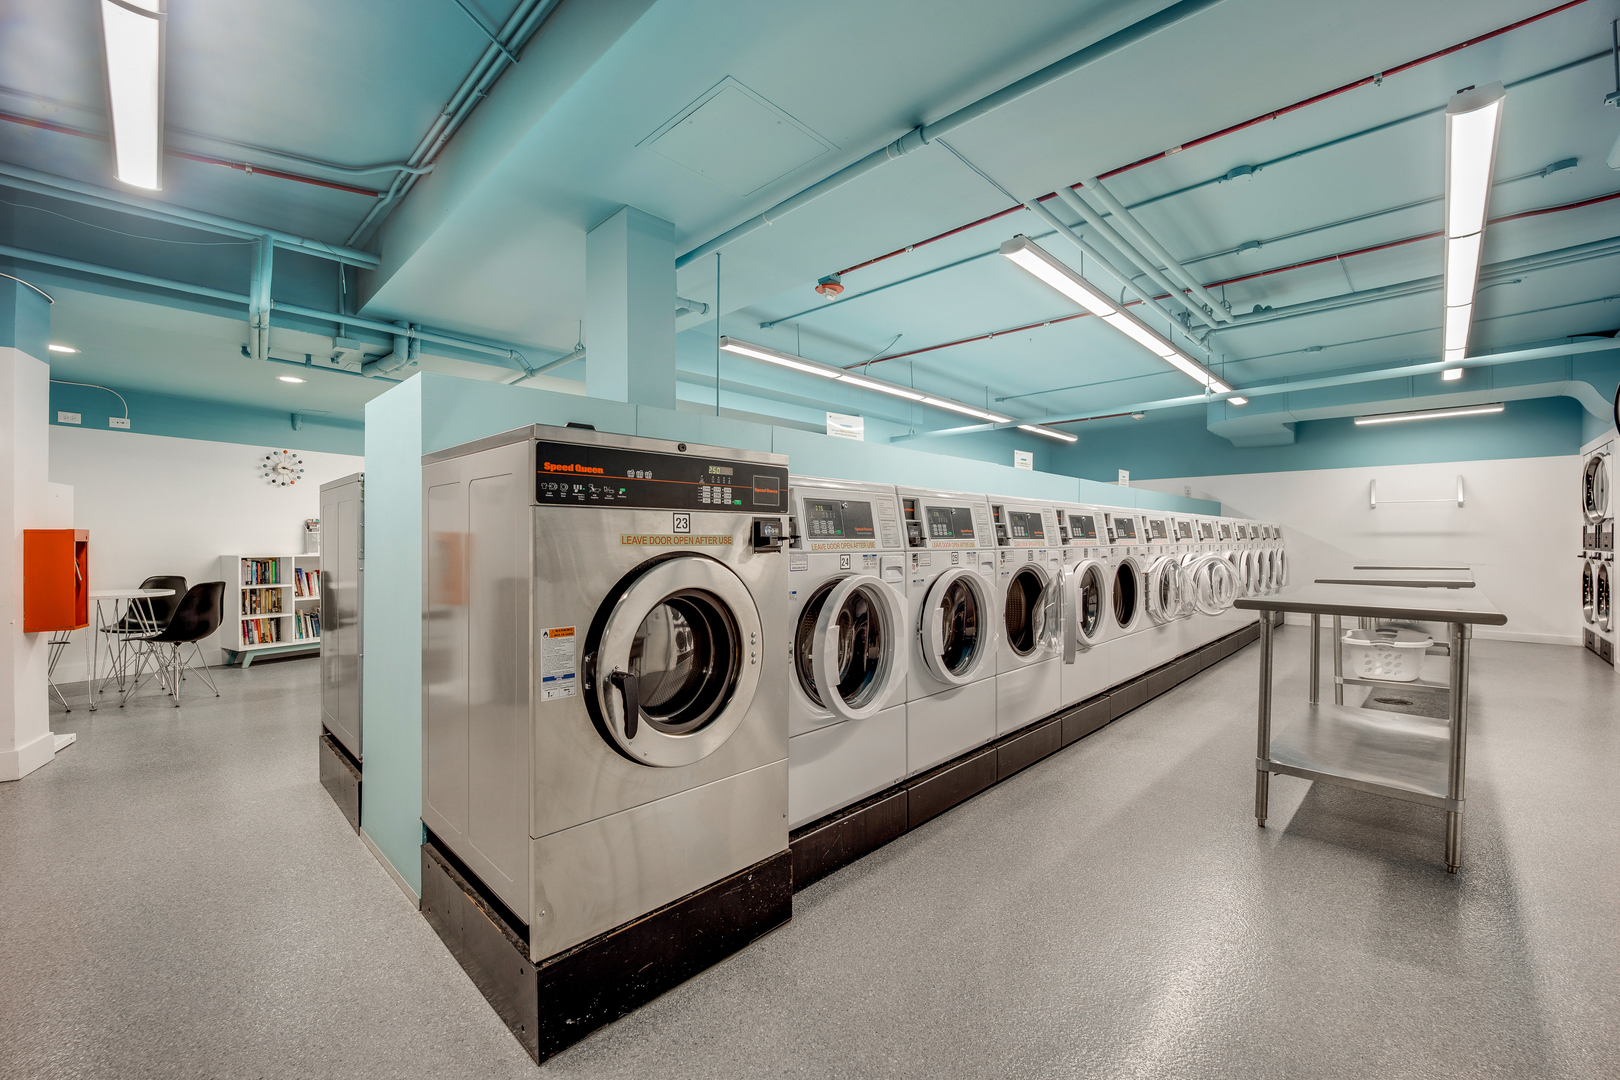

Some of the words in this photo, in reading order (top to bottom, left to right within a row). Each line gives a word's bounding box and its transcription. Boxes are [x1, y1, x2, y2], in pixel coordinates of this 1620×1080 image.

[543, 461, 575, 472] Speed
[574, 463, 604, 474] Queen
[675, 517, 688, 529] 23
[621, 535, 648, 545] LEAVE
[649, 536, 672, 545] DOOR
[673, 536, 694, 545] OPEN
[695, 536, 718, 545] AFTER
[718, 536, 732, 545] USE
[811, 543, 826, 551] LEAVE
[826, 542, 840, 550] DOOR
[841, 557, 849, 567] 24
